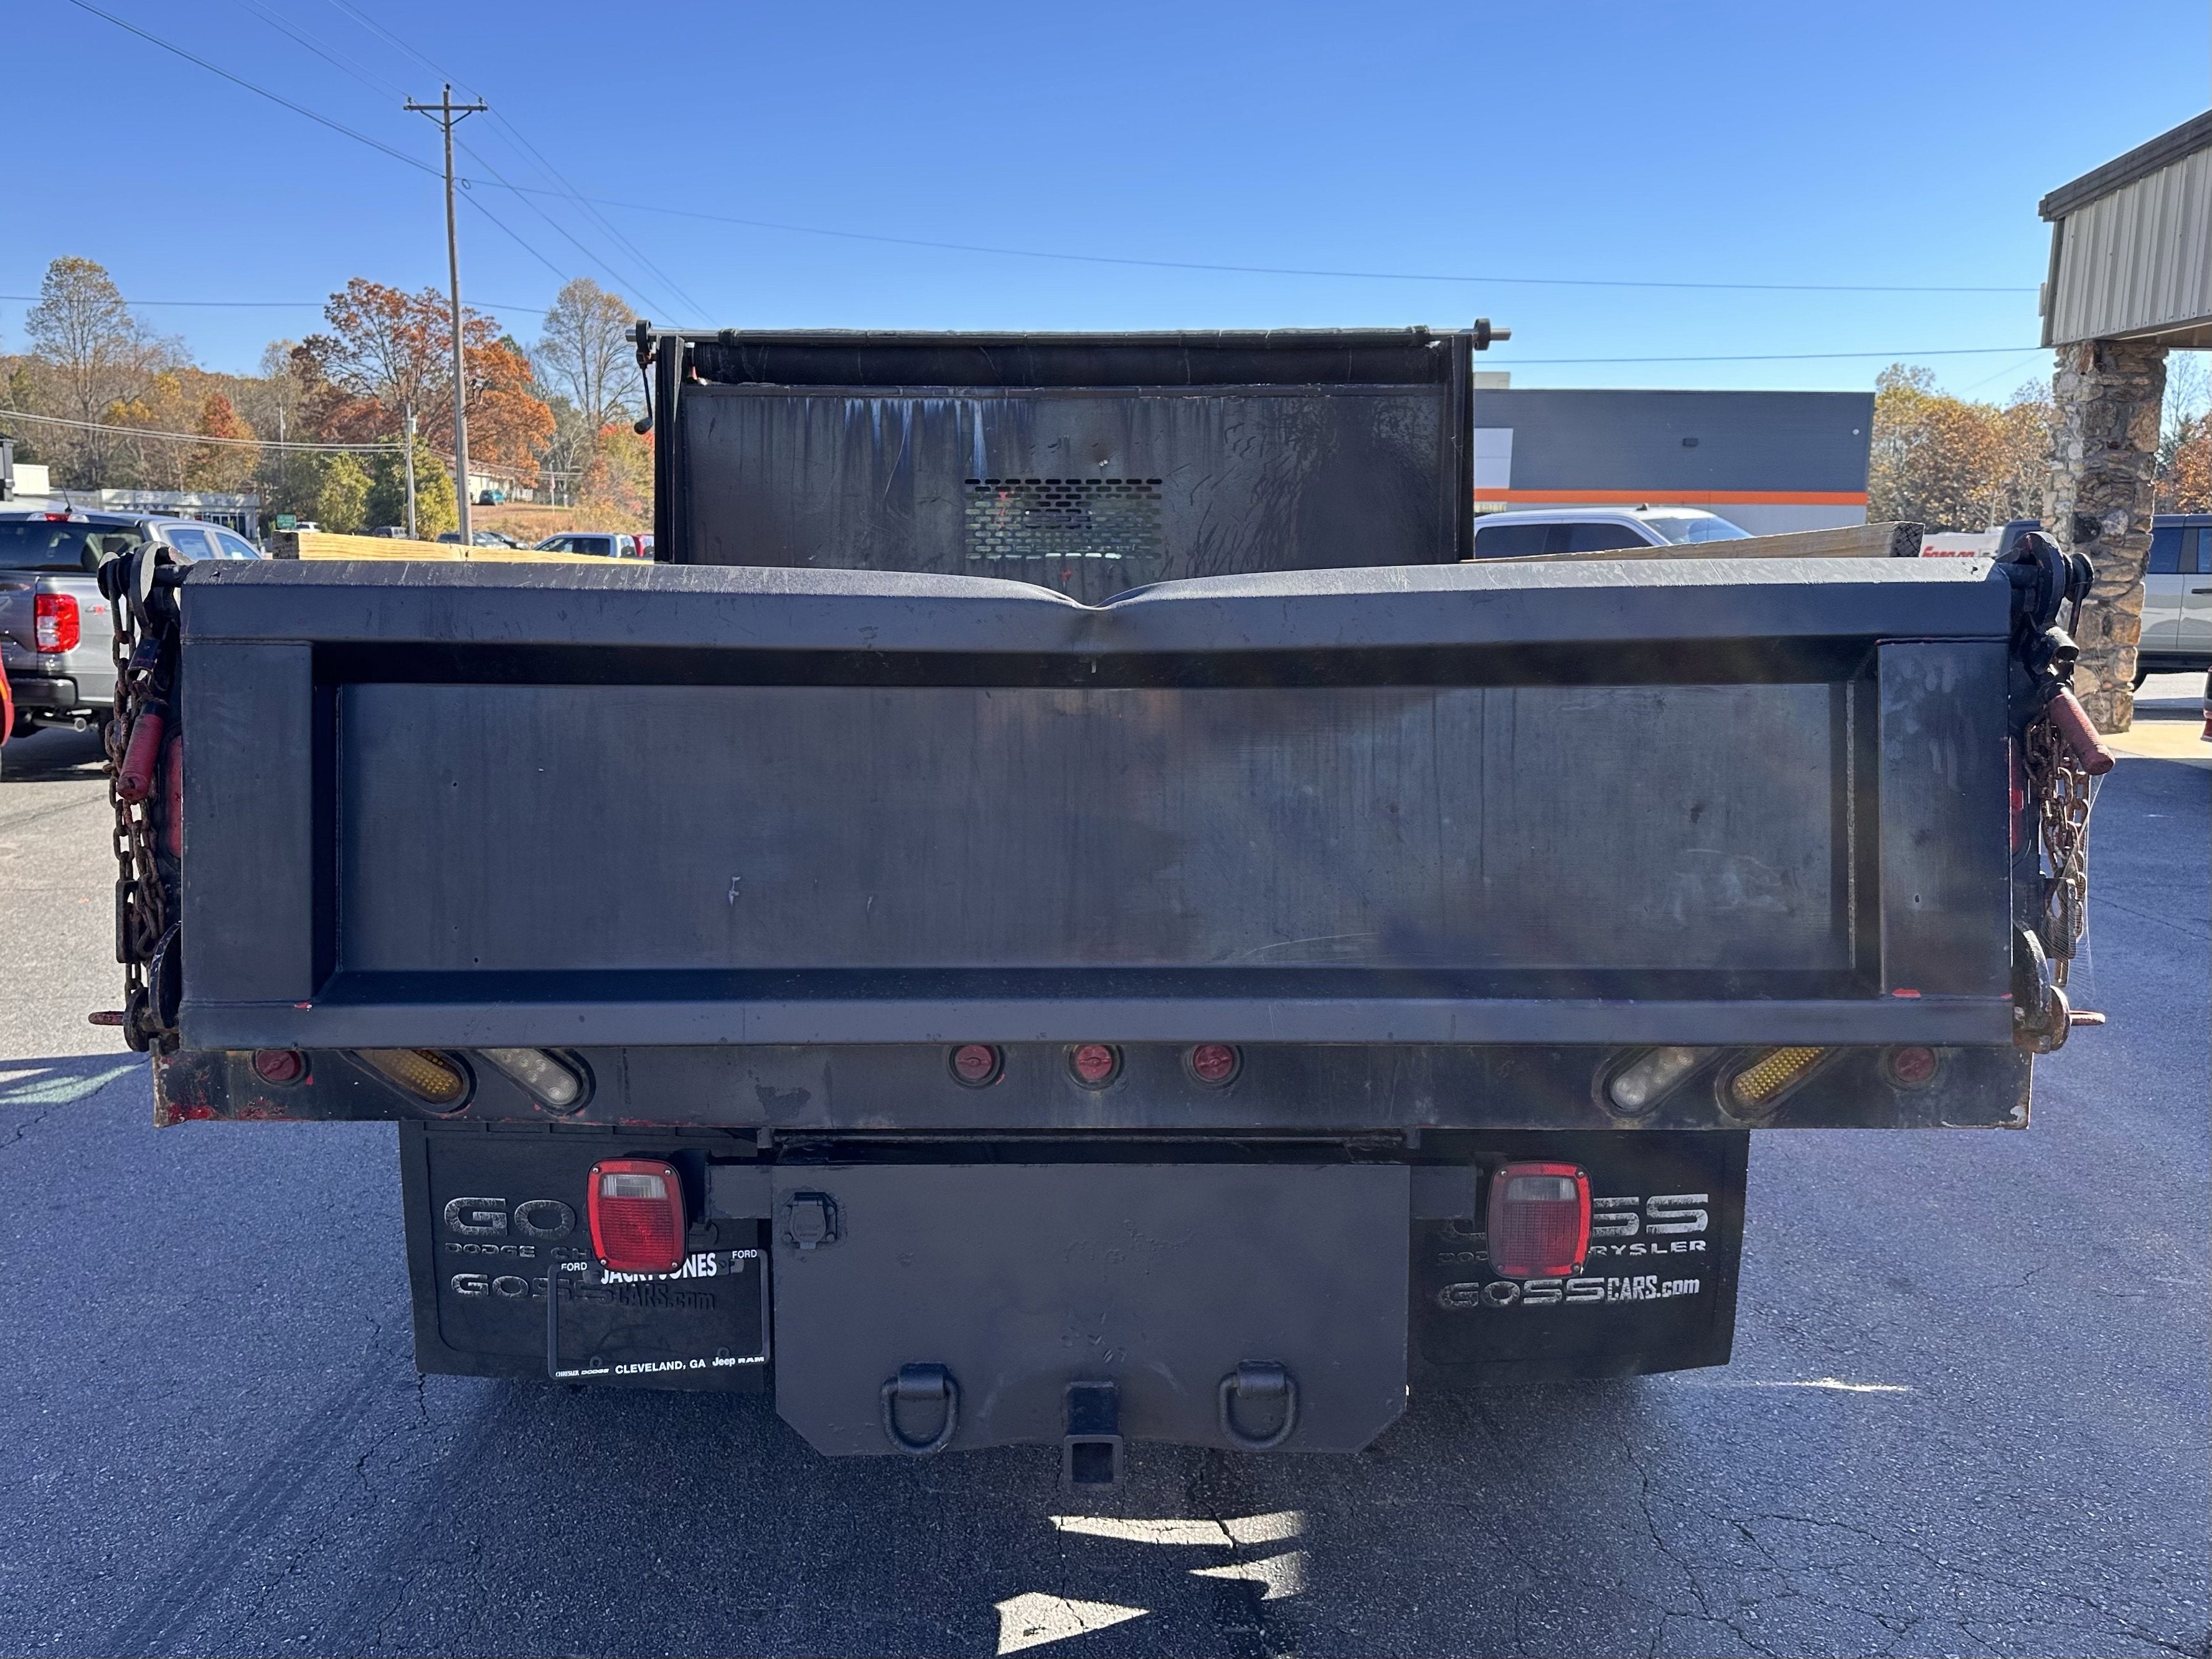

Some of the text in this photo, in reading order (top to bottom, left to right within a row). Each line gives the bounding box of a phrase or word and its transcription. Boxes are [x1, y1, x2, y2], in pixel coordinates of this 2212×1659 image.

[444, 1196, 577, 1240] GO
[445, 1243, 535, 1258] DODGE
[1589, 1240, 1706, 1256] RYSLER
[561, 1262, 587, 1272] FORD
[732, 1249, 758, 1259] FORD
[555, 1370, 580, 1378] CHRYSLER
[615, 1360, 686, 1375] CLEVELAND,
[689, 1358, 706, 1369] GA
[712, 1356, 736, 1367] Jeep
